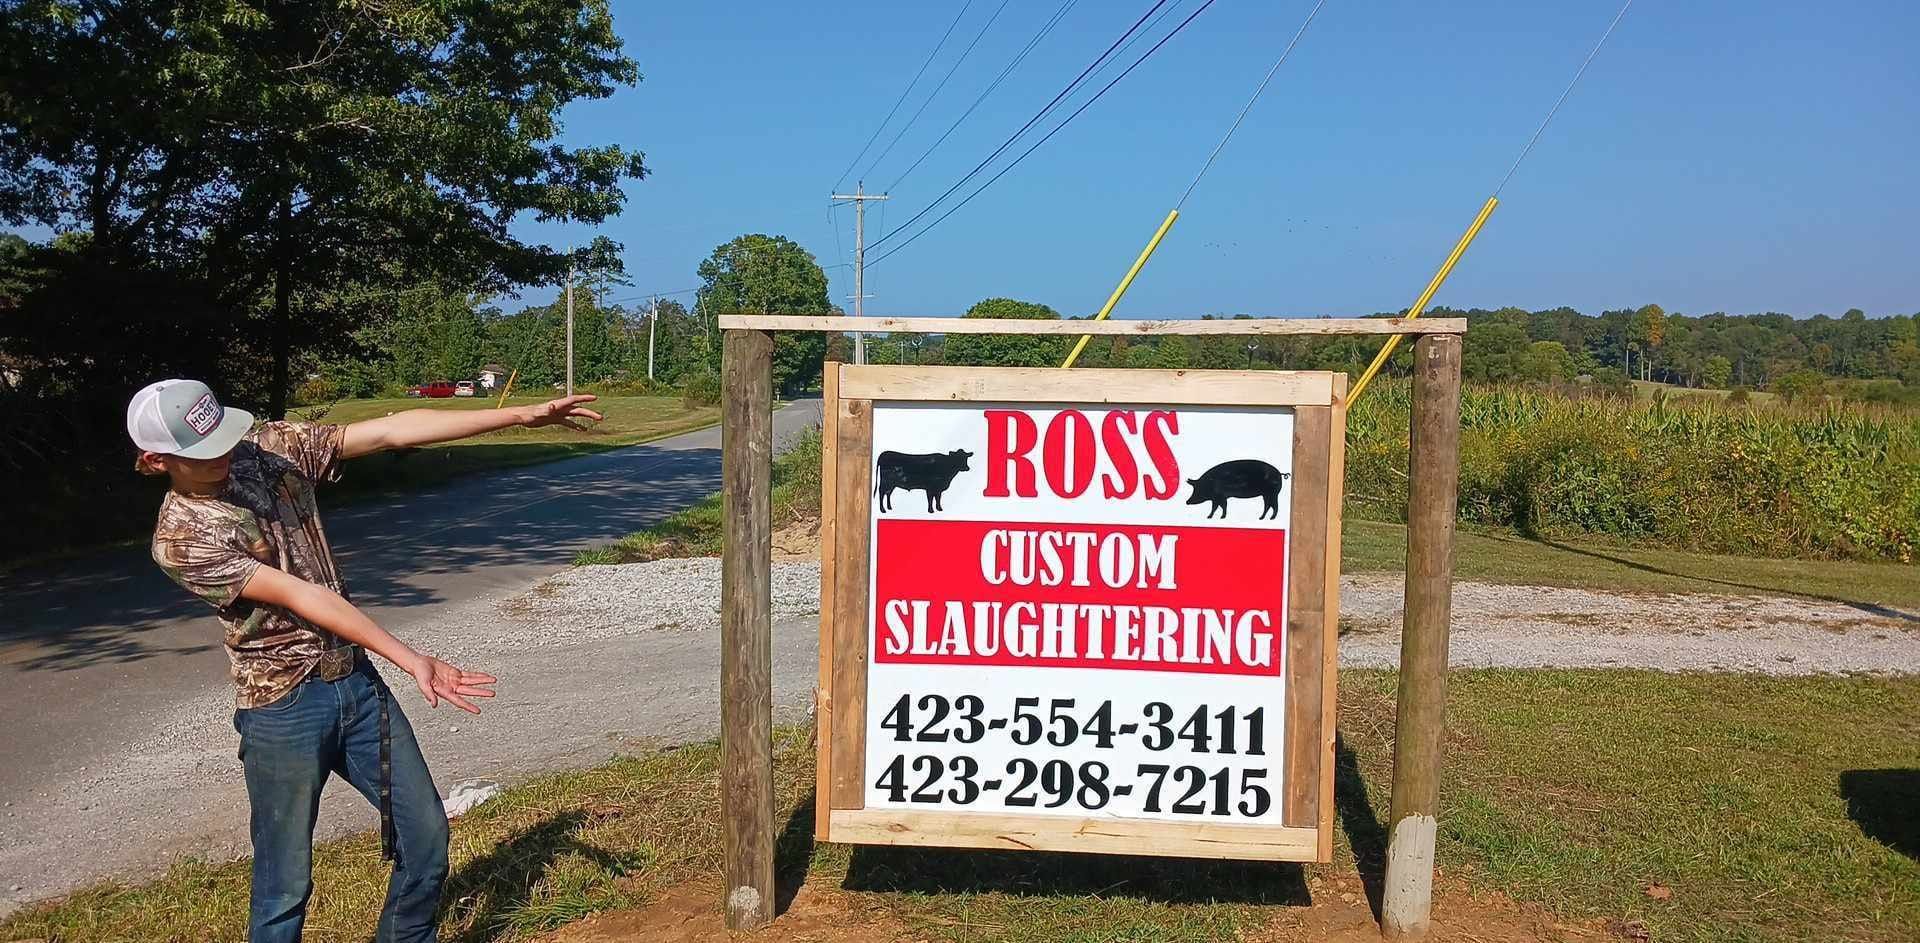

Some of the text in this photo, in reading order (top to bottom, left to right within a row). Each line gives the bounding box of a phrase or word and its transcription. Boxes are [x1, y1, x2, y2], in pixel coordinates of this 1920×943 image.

[982, 407, 1180, 501] ROSS
[980, 529, 1179, 590] CUSTOM
[885, 599, 1274, 667] SLAUGHTERING
[880, 693, 1267, 756] 423-554-3411
[875, 754, 1271, 818] 423-298-7215
